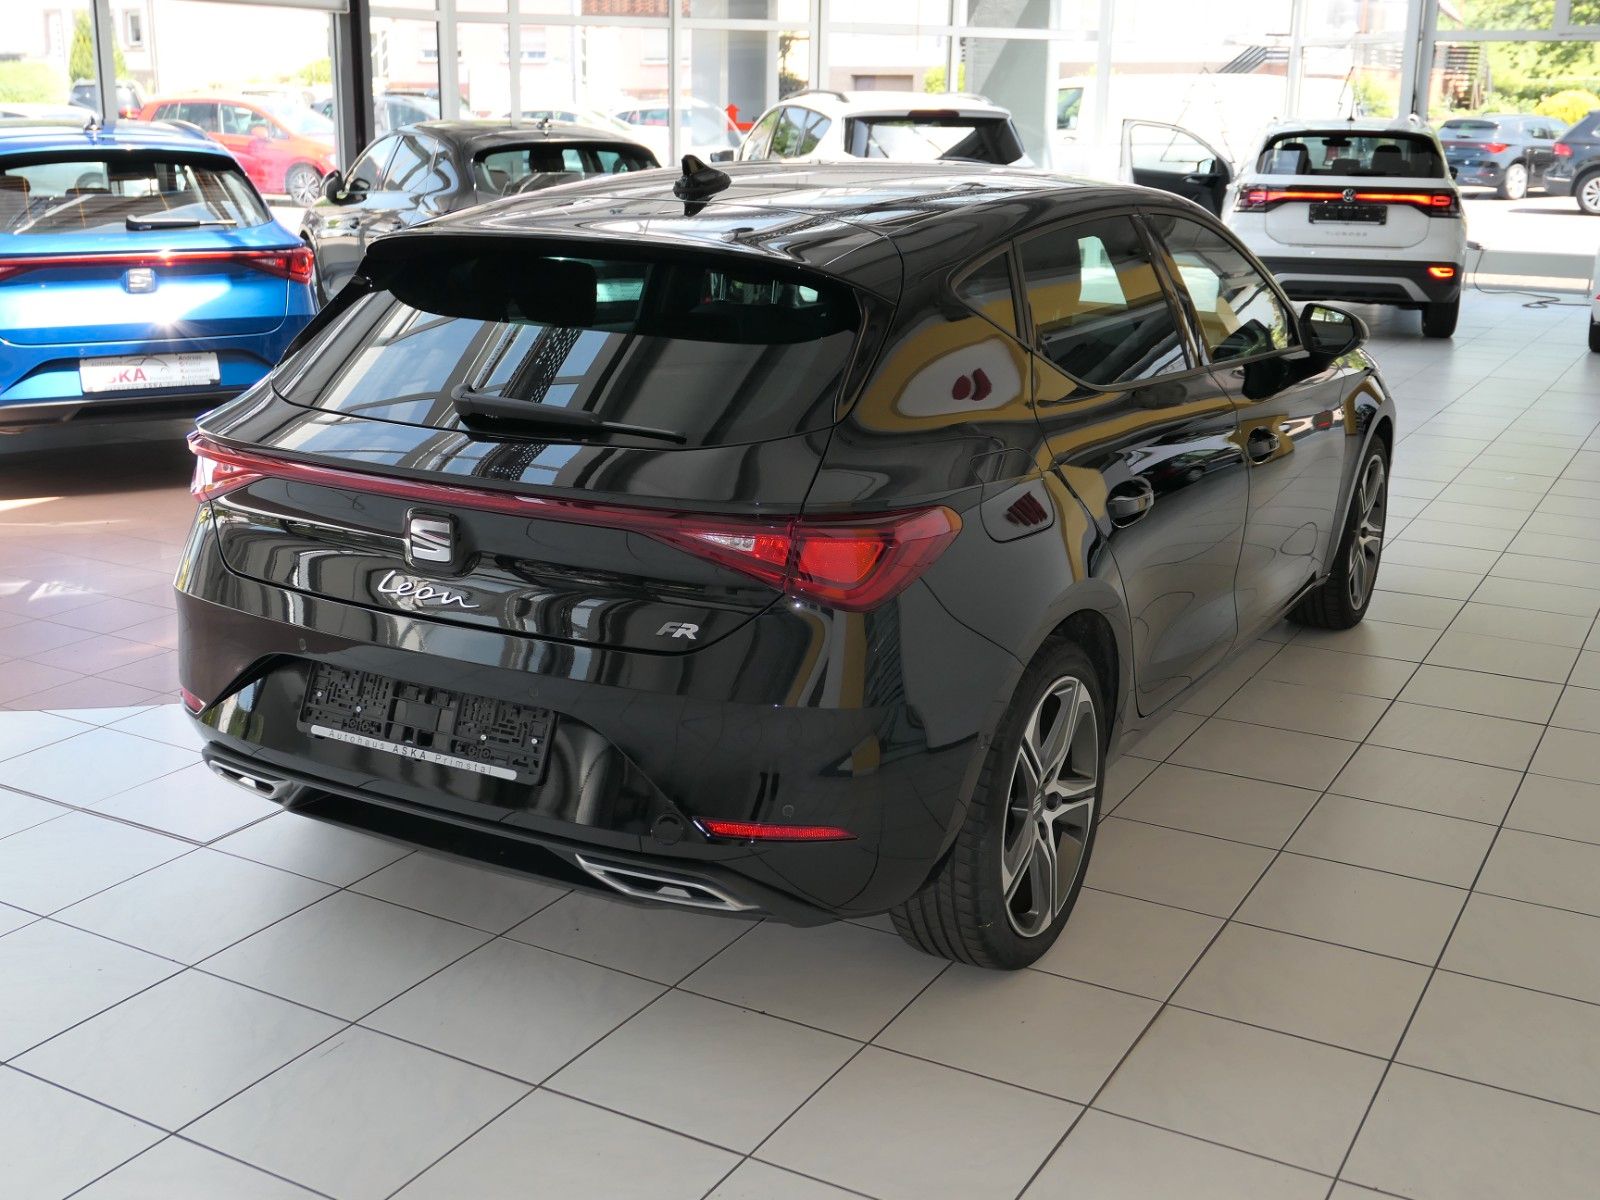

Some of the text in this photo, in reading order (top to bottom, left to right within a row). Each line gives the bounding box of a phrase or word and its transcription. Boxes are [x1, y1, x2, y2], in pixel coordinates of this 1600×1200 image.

[377, 569, 480, 608] Leon
[655, 621, 699, 640] FR
[328, 728, 492, 775] Autohaus ASKA Primstal
